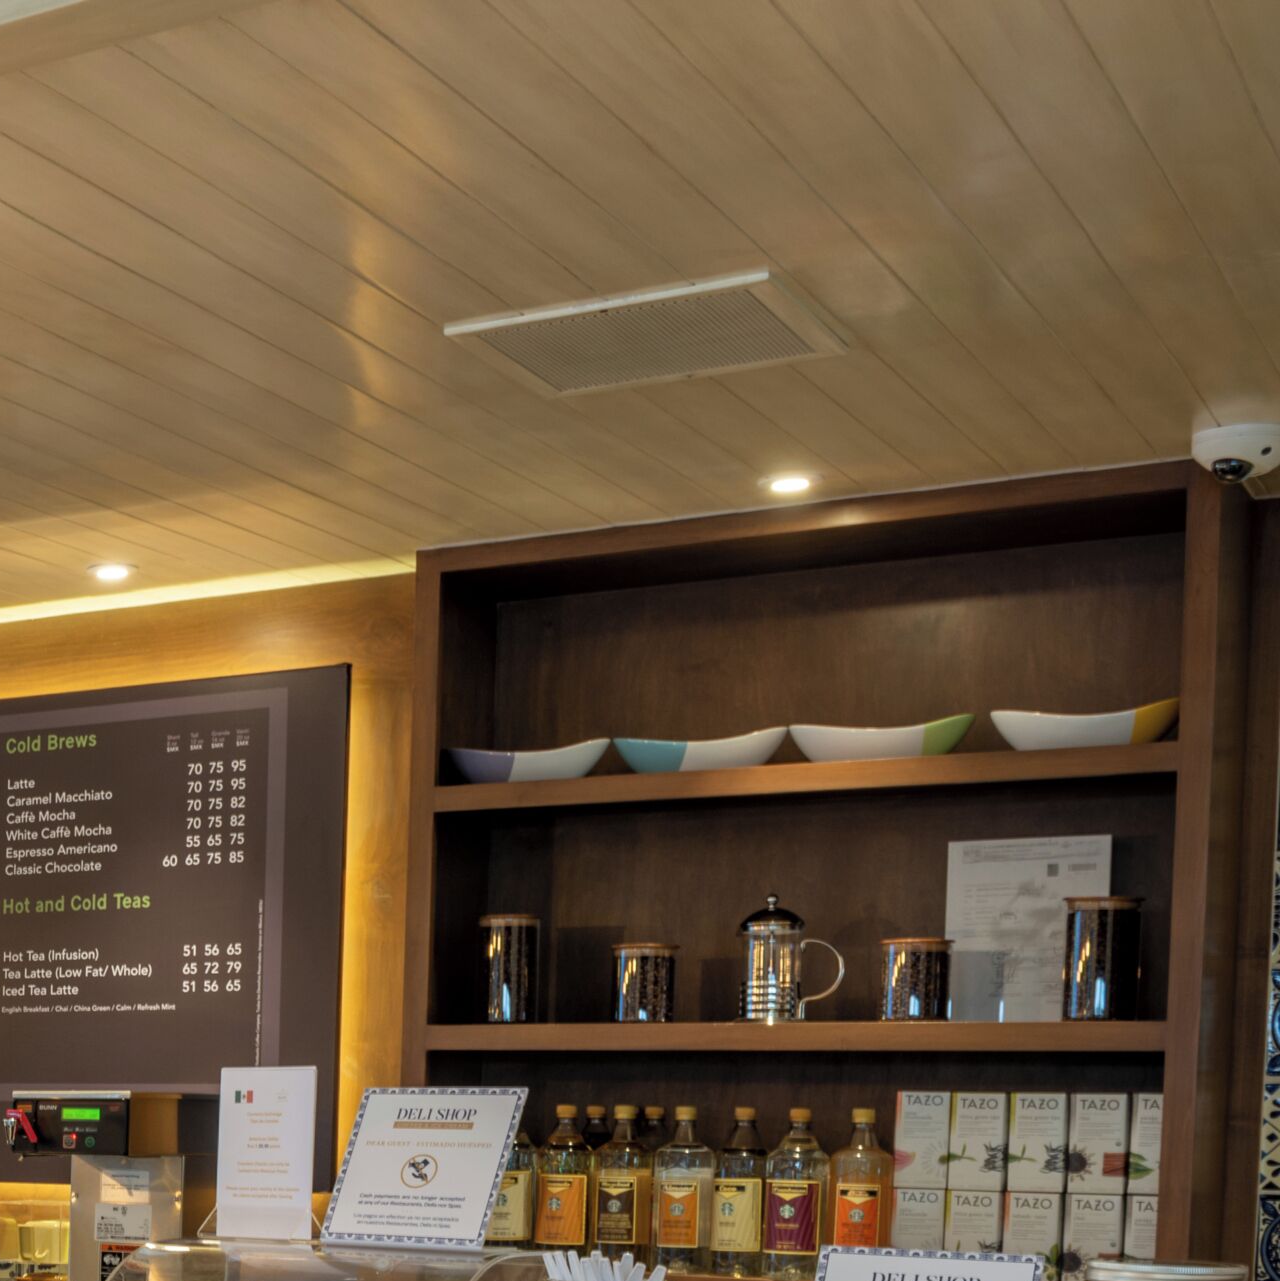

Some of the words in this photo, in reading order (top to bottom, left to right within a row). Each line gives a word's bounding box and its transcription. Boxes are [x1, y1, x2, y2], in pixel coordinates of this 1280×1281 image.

[6, 736, 40, 754] Cold
[48, 734, 97, 751] Brews
[188, 764, 202, 775] 70
[209, 762, 223, 773] 75
[231, 760, 246, 771] 95
[8, 779, 35, 790] Latte
[6, 846, 54, 860] Espresso
[57, 843, 117, 855] Americano
[162, 856, 177, 867] 60
[185, 854, 200, 865] 65
[207, 853, 221, 864] 75
[229, 852, 244, 863] 85
[5, 864, 42, 876] Classic
[45, 861, 102, 874] Chocolate
[3, 899, 30, 914] Hot
[36, 896, 65, 912] and
[71, 894, 107, 911] Cold
[113, 893, 150, 909] Teas
[4, 952, 23, 962] Hot
[27, 951, 45, 961] Tea
[48, 949, 99, 962] (Infusion)
[183, 945, 197, 957] 51
[204, 945, 219, 956] 56
[227, 944, 242, 955] 65
[3, 969, 20, 979] Tea
[24, 968, 52, 978] Latte
[55, 967, 82, 980] (Low
[85, 965, 108, 978] Fat/
[112, 964, 152, 978] Whole)
[2, 986, 25, 996] Iced
[28, 985, 46, 995] Tea
[50, 985, 78, 995] Latte
[905, 1094, 944, 1106] TAZO
[961, 1097, 998, 1110] TAZO
[1020, 1098, 1059, 1110] TAZO
[1080, 1099, 1120, 1111] TAZO
[397, 1108, 434, 1120] DELI
[436, 1108, 477, 1121] SHOP
[901, 1192, 939, 1203] TAZO
[955, 1195, 992, 1207] TAZO
[1014, 1196, 1053, 1209] TAZO
[1075, 1200, 1115, 1211] TAZO
